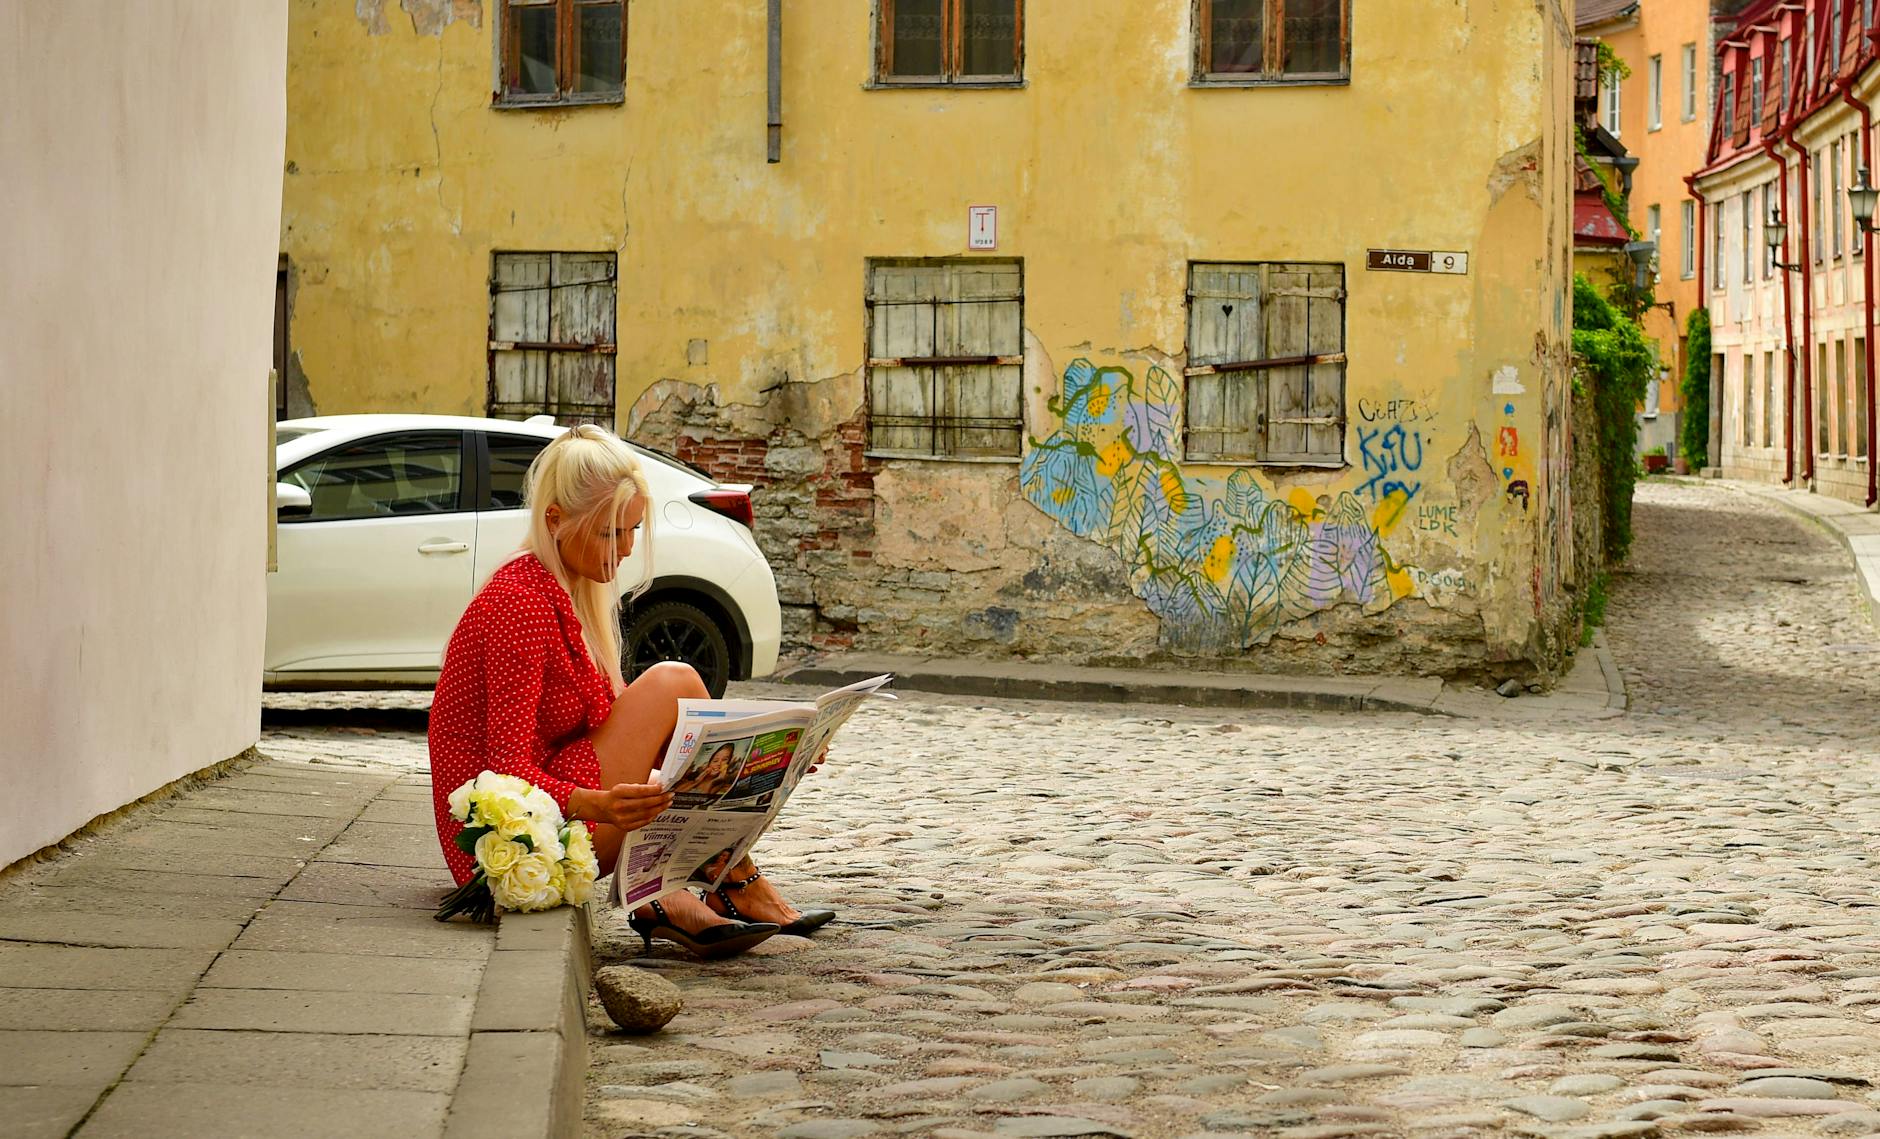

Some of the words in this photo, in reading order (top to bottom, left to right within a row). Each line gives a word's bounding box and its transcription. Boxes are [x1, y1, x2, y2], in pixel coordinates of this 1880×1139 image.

[1383, 254, 1415, 265] Aida
[1444, 256, 1455, 269] 9
[1419, 505, 1457, 523] LUME
[1419, 519, 1458, 537] LDK
